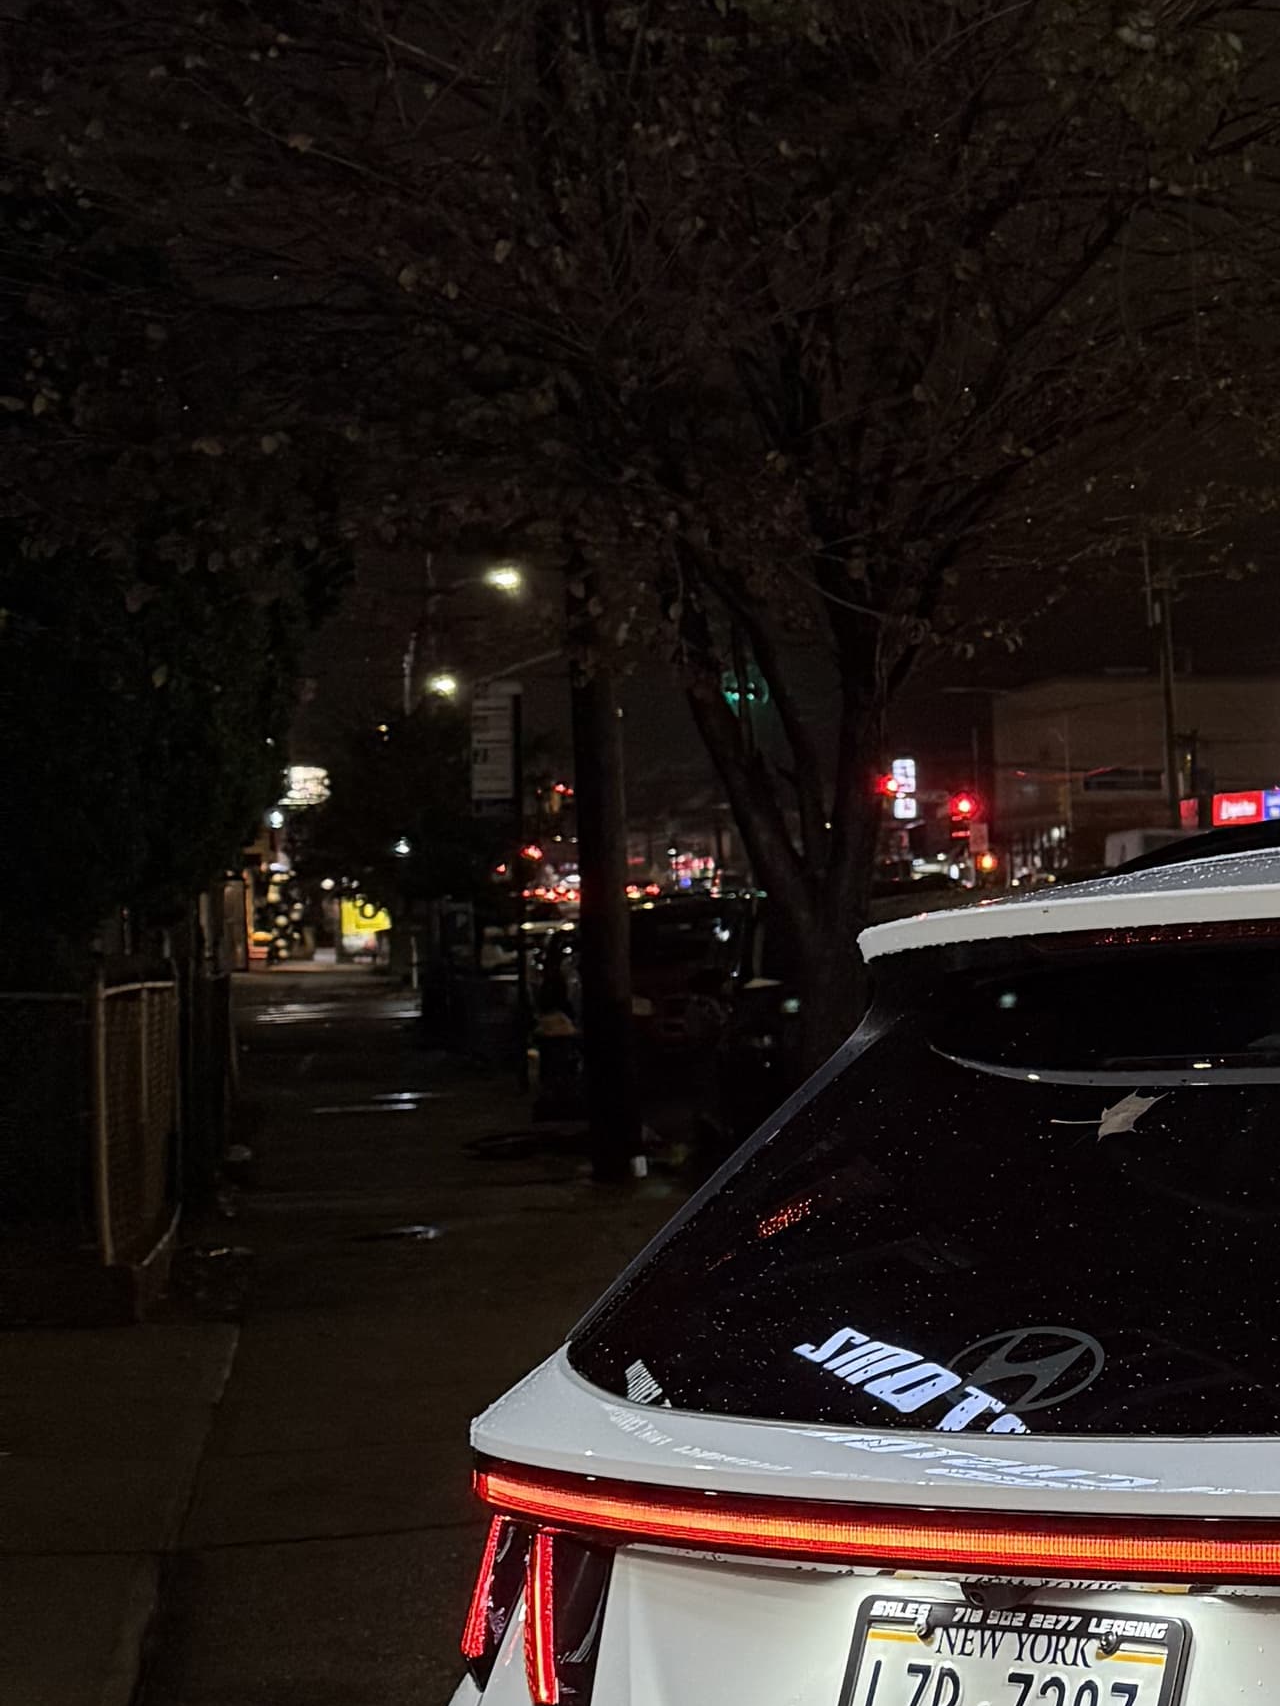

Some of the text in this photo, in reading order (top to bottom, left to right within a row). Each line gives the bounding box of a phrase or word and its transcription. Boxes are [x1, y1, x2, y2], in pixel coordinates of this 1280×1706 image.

[870, 1600, 932, 1621] SALES
[952, 1607, 984, 1624] 718
[1028, 1612, 1083, 1632] 2277
[1087, 1617, 1169, 1639] LEASING
[935, 1627, 1093, 1669] NEW YORK
